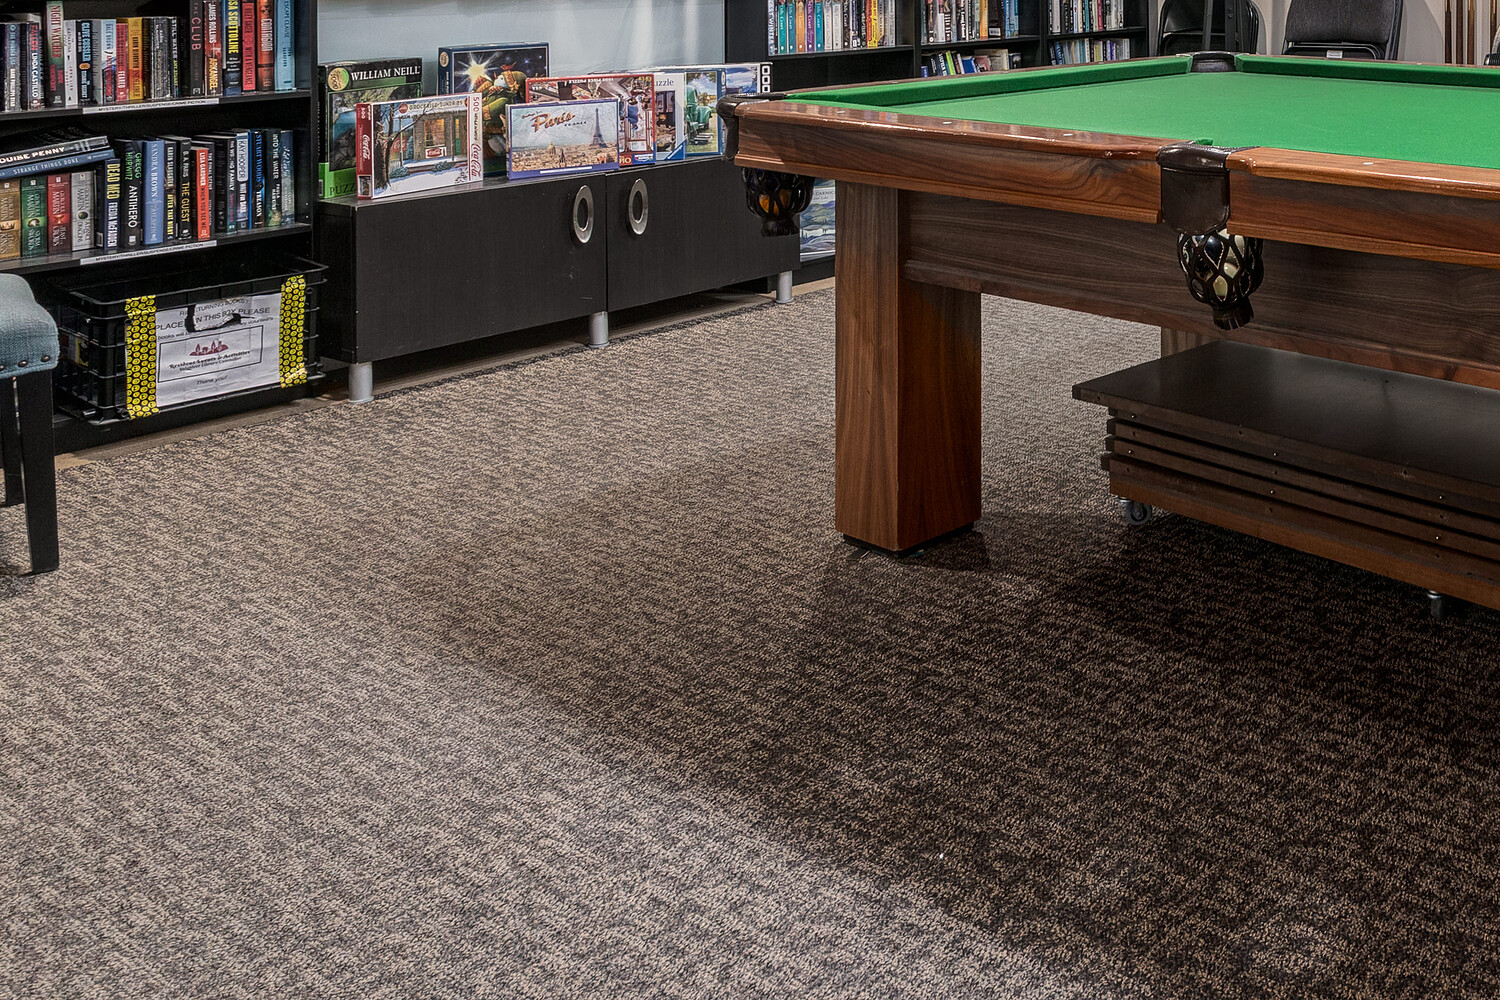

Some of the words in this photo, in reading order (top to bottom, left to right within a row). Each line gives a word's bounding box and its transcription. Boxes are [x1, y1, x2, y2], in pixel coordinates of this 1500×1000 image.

[51, 5, 60, 27] NIGHT
[82, 23, 90, 38] CLIVE
[192, 17, 201, 50] CLUB
[228, 11, 238, 53] SCOTTOLINE
[261, 18, 272, 51] CONTAGION
[51, 28, 61, 59] WATCHER
[350, 69, 391, 81] WILLIAM
[394, 66, 420, 76] NEILL
[530, 111, 575, 132] Paris
[0, 153, 30, 163] OUISE
[32, 147, 65, 157] PENNY
[107, 164, 120, 182] DEAD
[107, 184, 120, 199] MED
[128, 186, 137, 228] ANTIHERO
[238, 307, 270, 315] PLEASE
